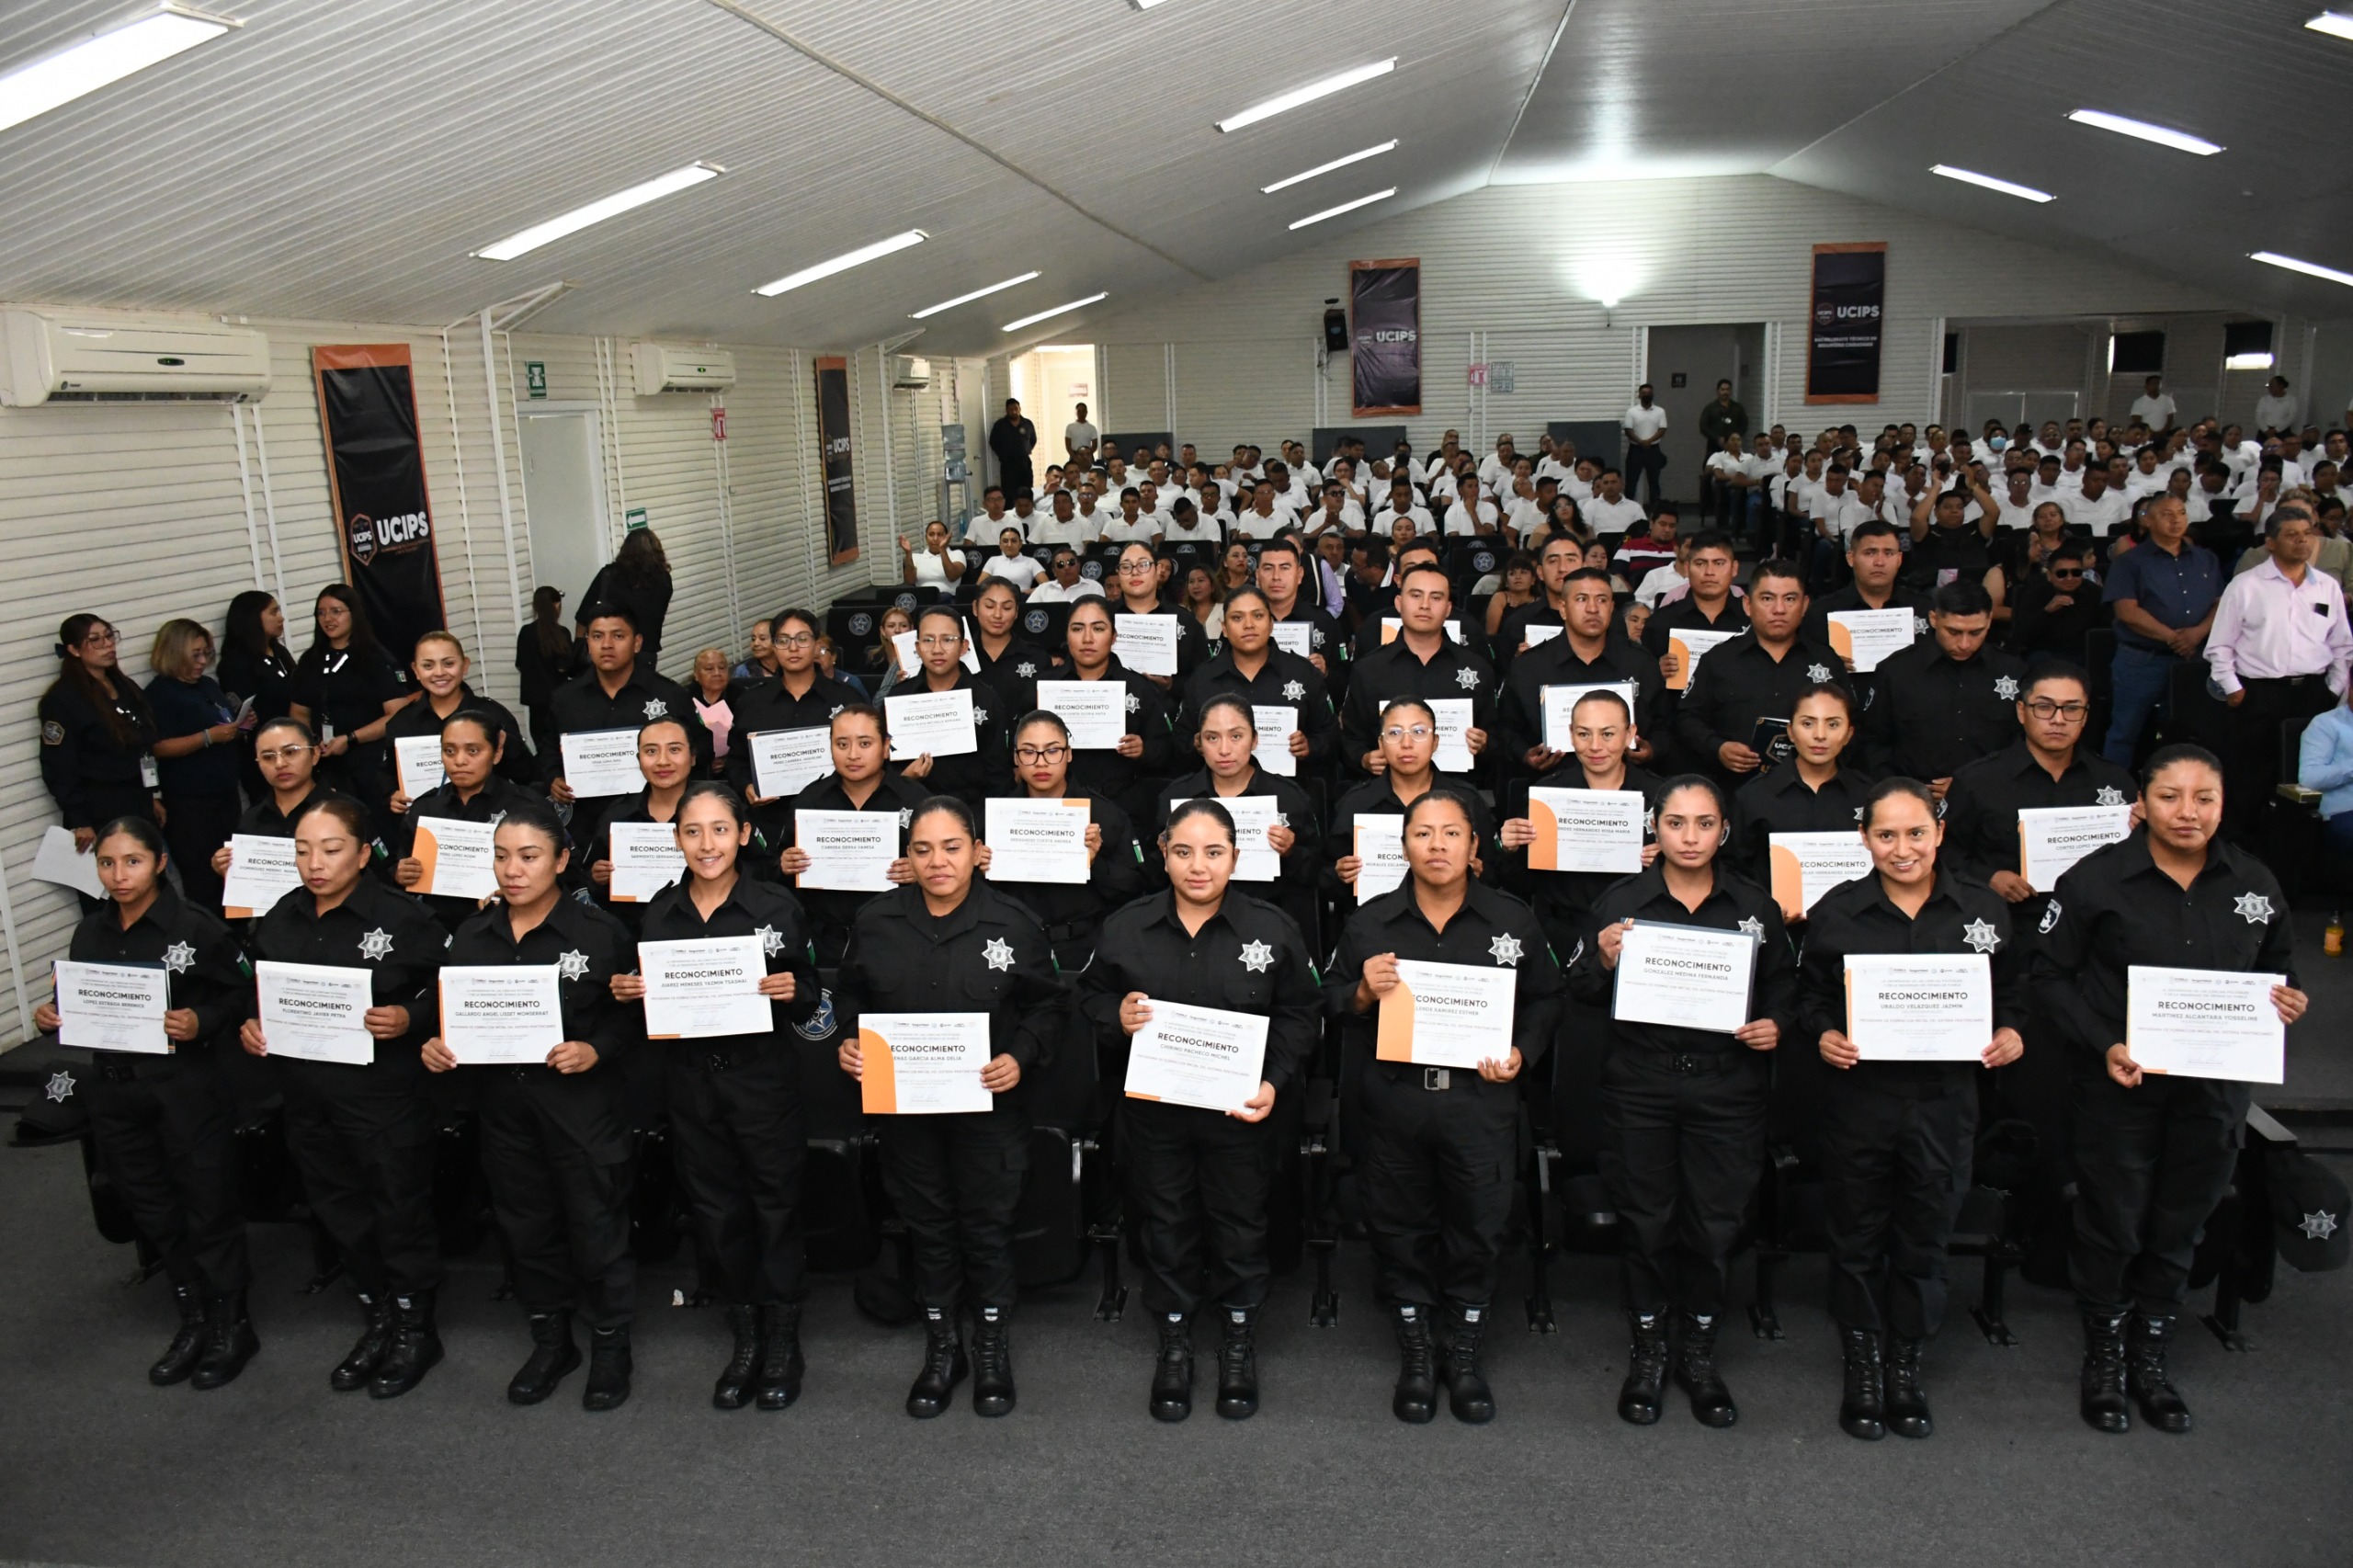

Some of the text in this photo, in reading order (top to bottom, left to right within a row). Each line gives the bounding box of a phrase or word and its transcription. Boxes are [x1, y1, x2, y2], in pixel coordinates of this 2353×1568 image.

[1837, 305, 1880, 318] UCIPS
[1376, 330, 1416, 342] UCIPS
[834, 437, 849, 453] UCIPS
[377, 511, 428, 545] UCIPS
[353, 531, 372, 543] UCIPS
[904, 711, 958, 721] RECONOCIMIENTO
[580, 751, 634, 759] RECONOCIMIENTO
[770, 748, 824, 759] RECONOCIMIENTO
[1559, 818, 1628, 826] RECONOCIMIENTO
[2048, 832, 2120, 844] RECONOCIMIENTO
[437, 844, 489, 853] CONOCIMIENTO
[248, 858, 296, 867] RECONOCIMIE
[1645, 958, 1731, 971] RECONOCIMIENTO
[665, 969, 743, 979] RECONOCIMIENTO
[78, 989, 151, 1001] RECONOCIMIENTO
[1414, 995, 1488, 1007] CONOCIMIENTO
[279, 998, 352, 1010] RECONOCIMIENTO
[2158, 1002, 2255, 1012] RECONOCIMIENTO
[1158, 1033, 1239, 1053] RECONOCIMIENTO
